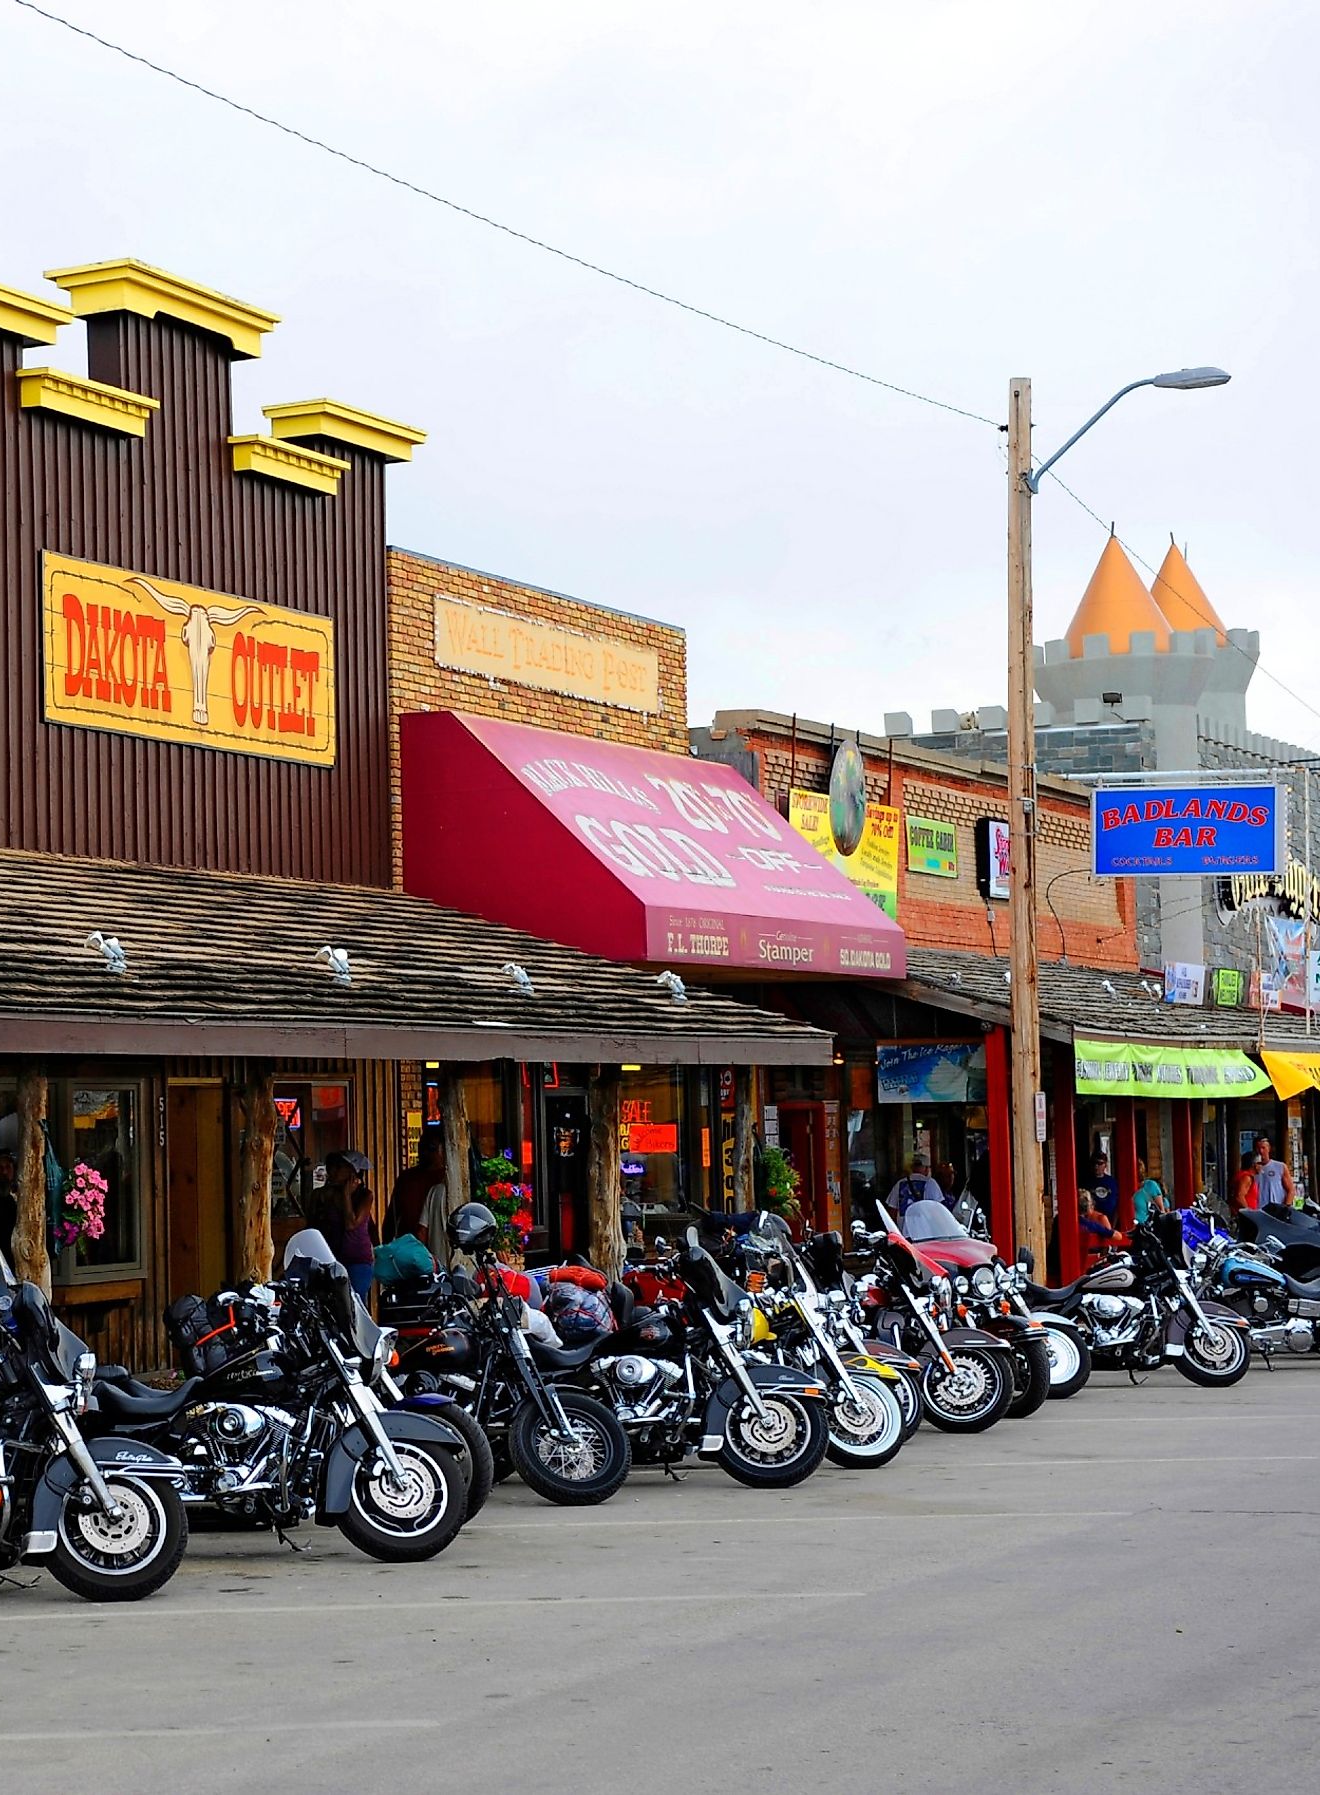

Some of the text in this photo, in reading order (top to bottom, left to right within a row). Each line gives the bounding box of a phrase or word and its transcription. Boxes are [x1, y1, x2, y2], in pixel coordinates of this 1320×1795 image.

[62, 594, 172, 712] DAKOTA
[445, 608, 647, 692] WALL TRADING POST
[232, 632, 320, 737] OUTLET
[1101, 797, 1270, 831] BADLANDS
[574, 814, 736, 888] GOLD
[1152, 826, 1217, 848] BAR
[690, 933, 729, 956] THORPE
[759, 939, 814, 966] Stamper
[621, 1100, 652, 1123] SALE
